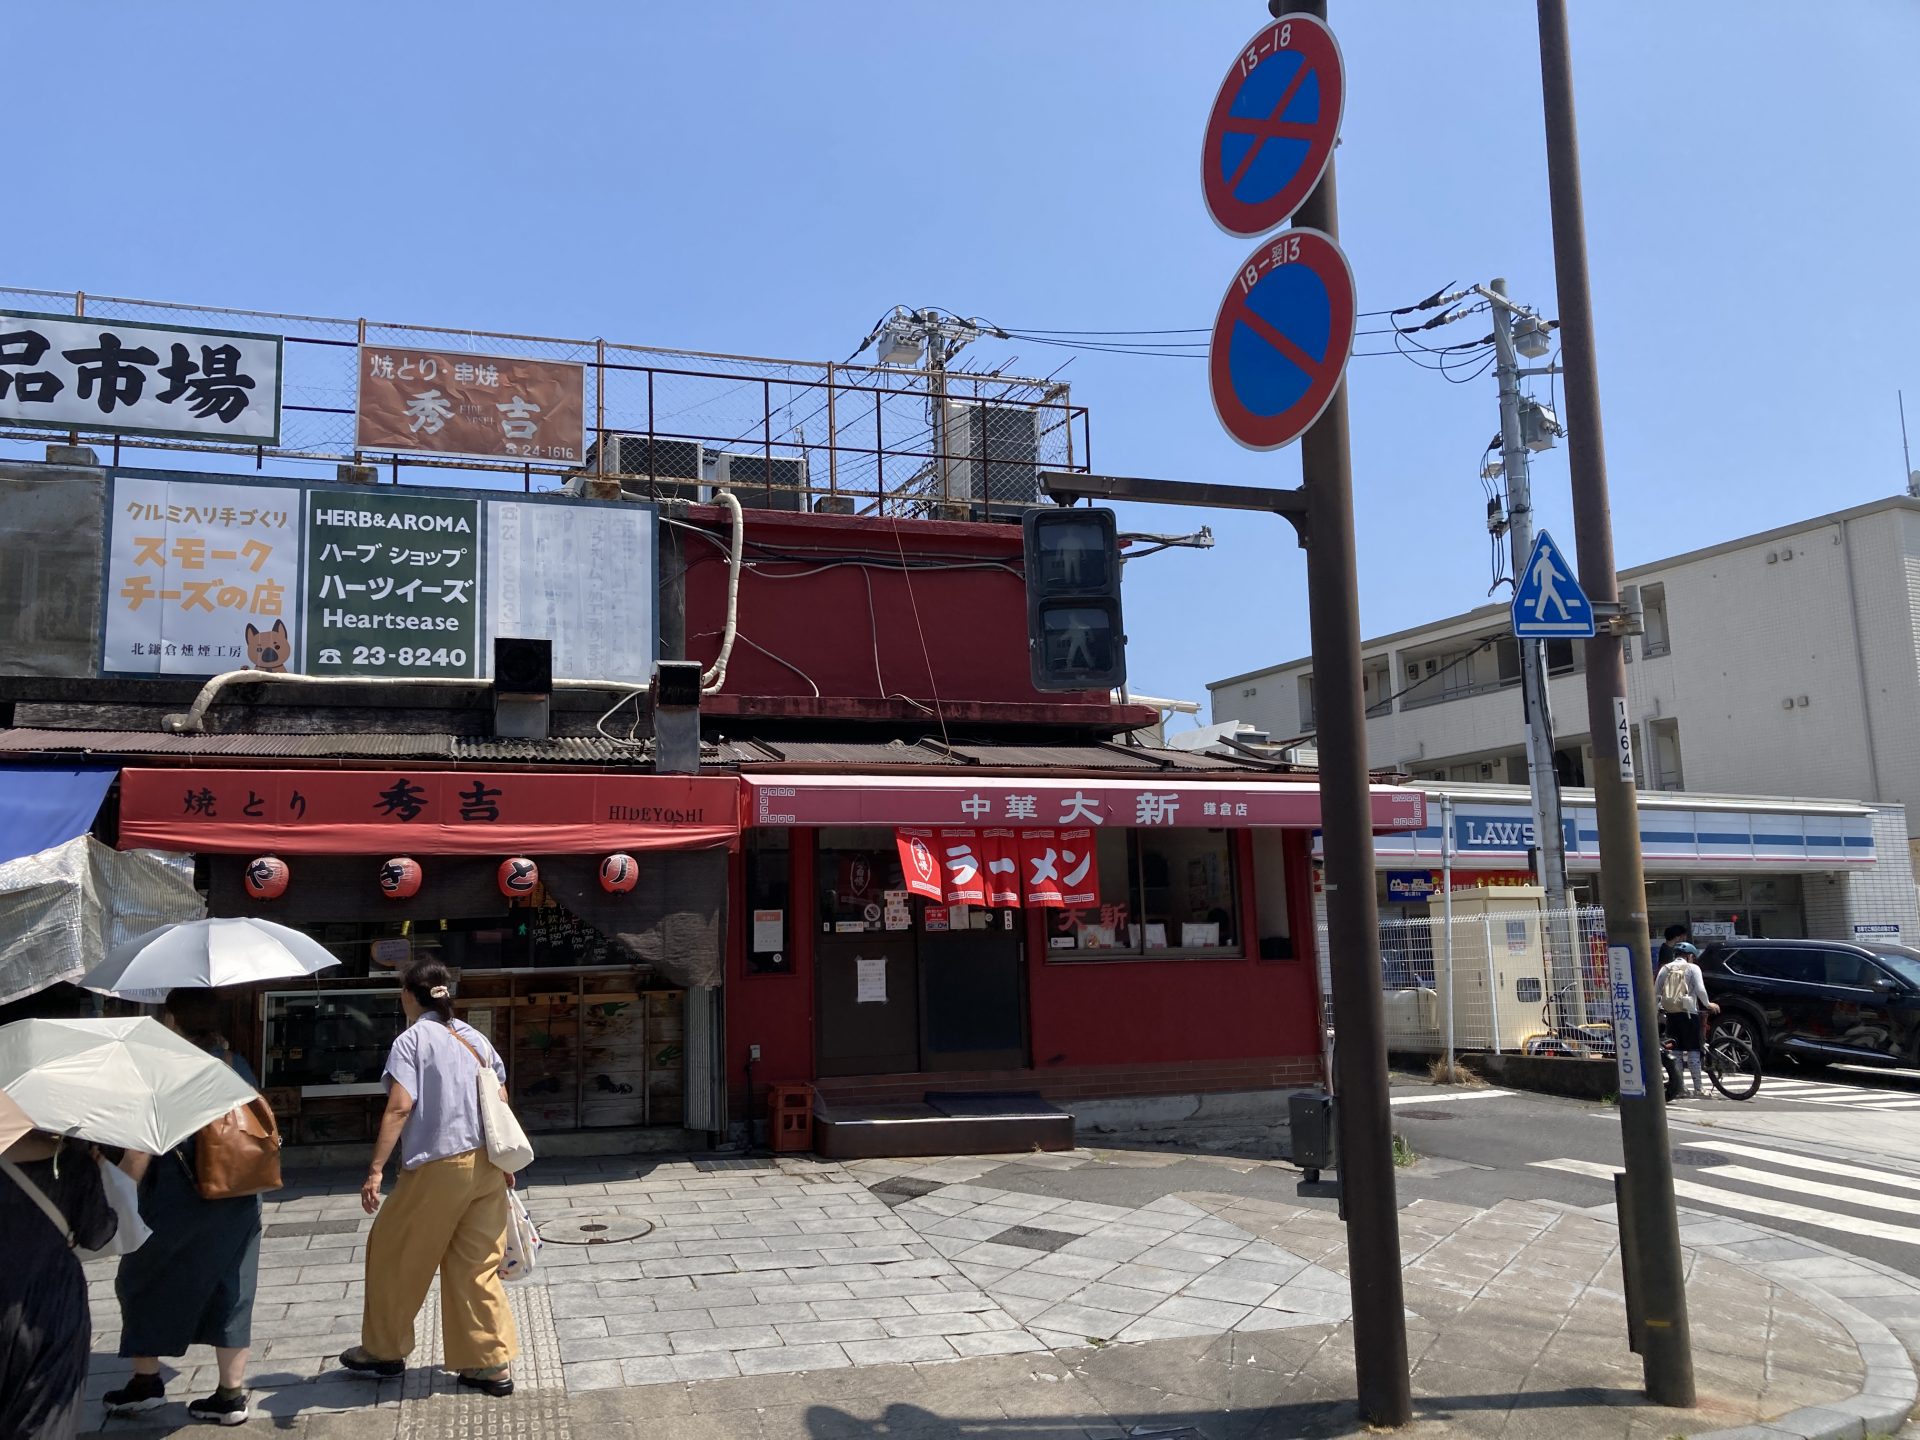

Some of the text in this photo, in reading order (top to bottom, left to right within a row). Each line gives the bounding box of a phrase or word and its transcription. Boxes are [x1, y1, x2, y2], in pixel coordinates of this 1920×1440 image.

[1240, 23, 1292, 77] 13-18
[1239, 236, 1301, 293] 18-翌13
[522, 446, 574, 460] 24-1616
[316, 508, 472, 533] HERB&AROMA
[132, 537, 274, 573] スモーク
[120, 576, 286, 616] チーズの店
[318, 574, 474, 604] ハーツイーズ
[323, 608, 460, 631] Heartsease
[352, 646, 467, 667] 23-8240
[1618, 701, 1631, 767] 1464
[183, 778, 704, 823] 焼とり 秀吉 HIDEYOSHI
[961, 791, 1248, 825] 中華 大新 鎌倉店
[506, 861, 535, 891] と
[602, 854, 629, 884] り
[946, 844, 1091, 888] ラーメン
